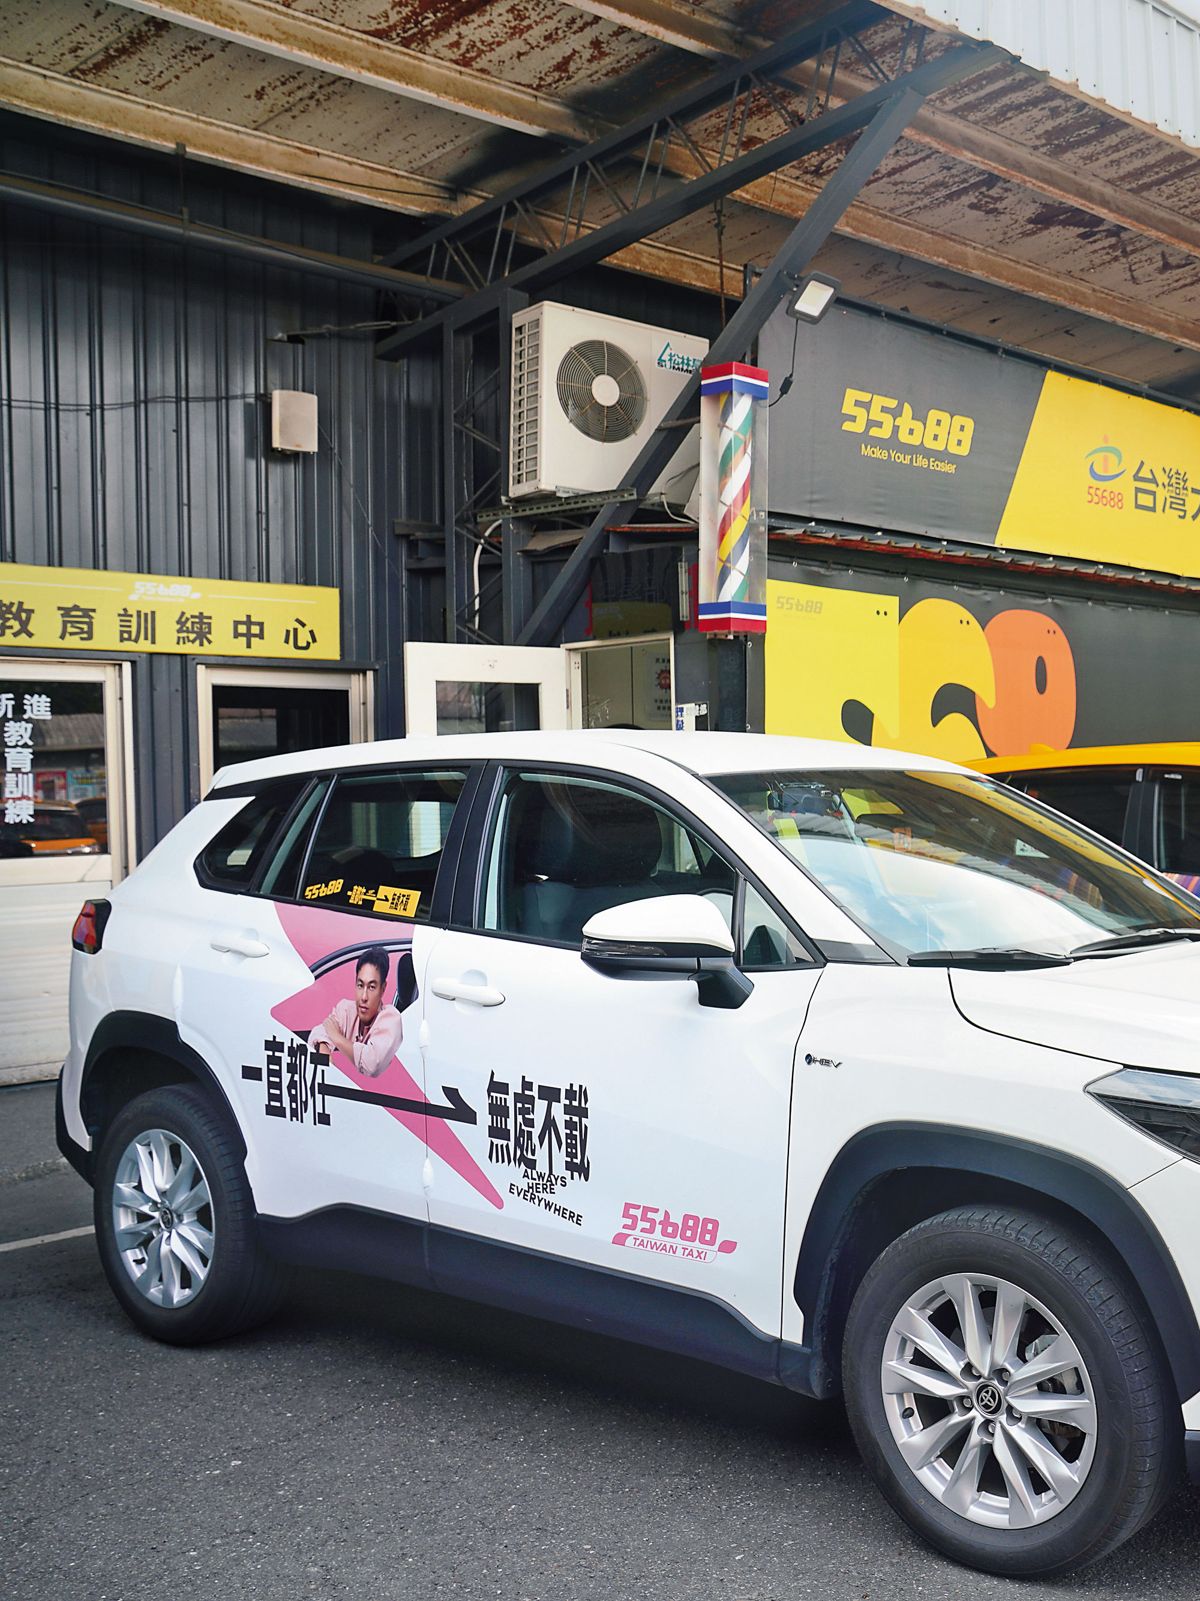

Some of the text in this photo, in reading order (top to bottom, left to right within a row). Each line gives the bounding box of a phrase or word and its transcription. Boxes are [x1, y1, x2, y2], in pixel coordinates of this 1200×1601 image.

[841, 387, 975, 457] 55688
[860, 443, 957, 474] Make Your Life Easier
[1087, 485, 1124, 511] 55688
[776, 595, 823, 615] 55688
[0, 600, 317, 651] 教育訓練中心
[3, 720, 35, 824] 教育訓練
[304, 879, 344, 899] 55688
[241, 1034, 590, 1182] 一直都在 無處不載
[522, 1168, 568, 1188] ALWAYS
[527, 1182, 556, 1195] HERE
[508, 1183, 584, 1227] EVERYWHERE
[621, 1202, 720, 1247] 55688
[632, 1237, 708, 1261] TAIWAN TAXI
